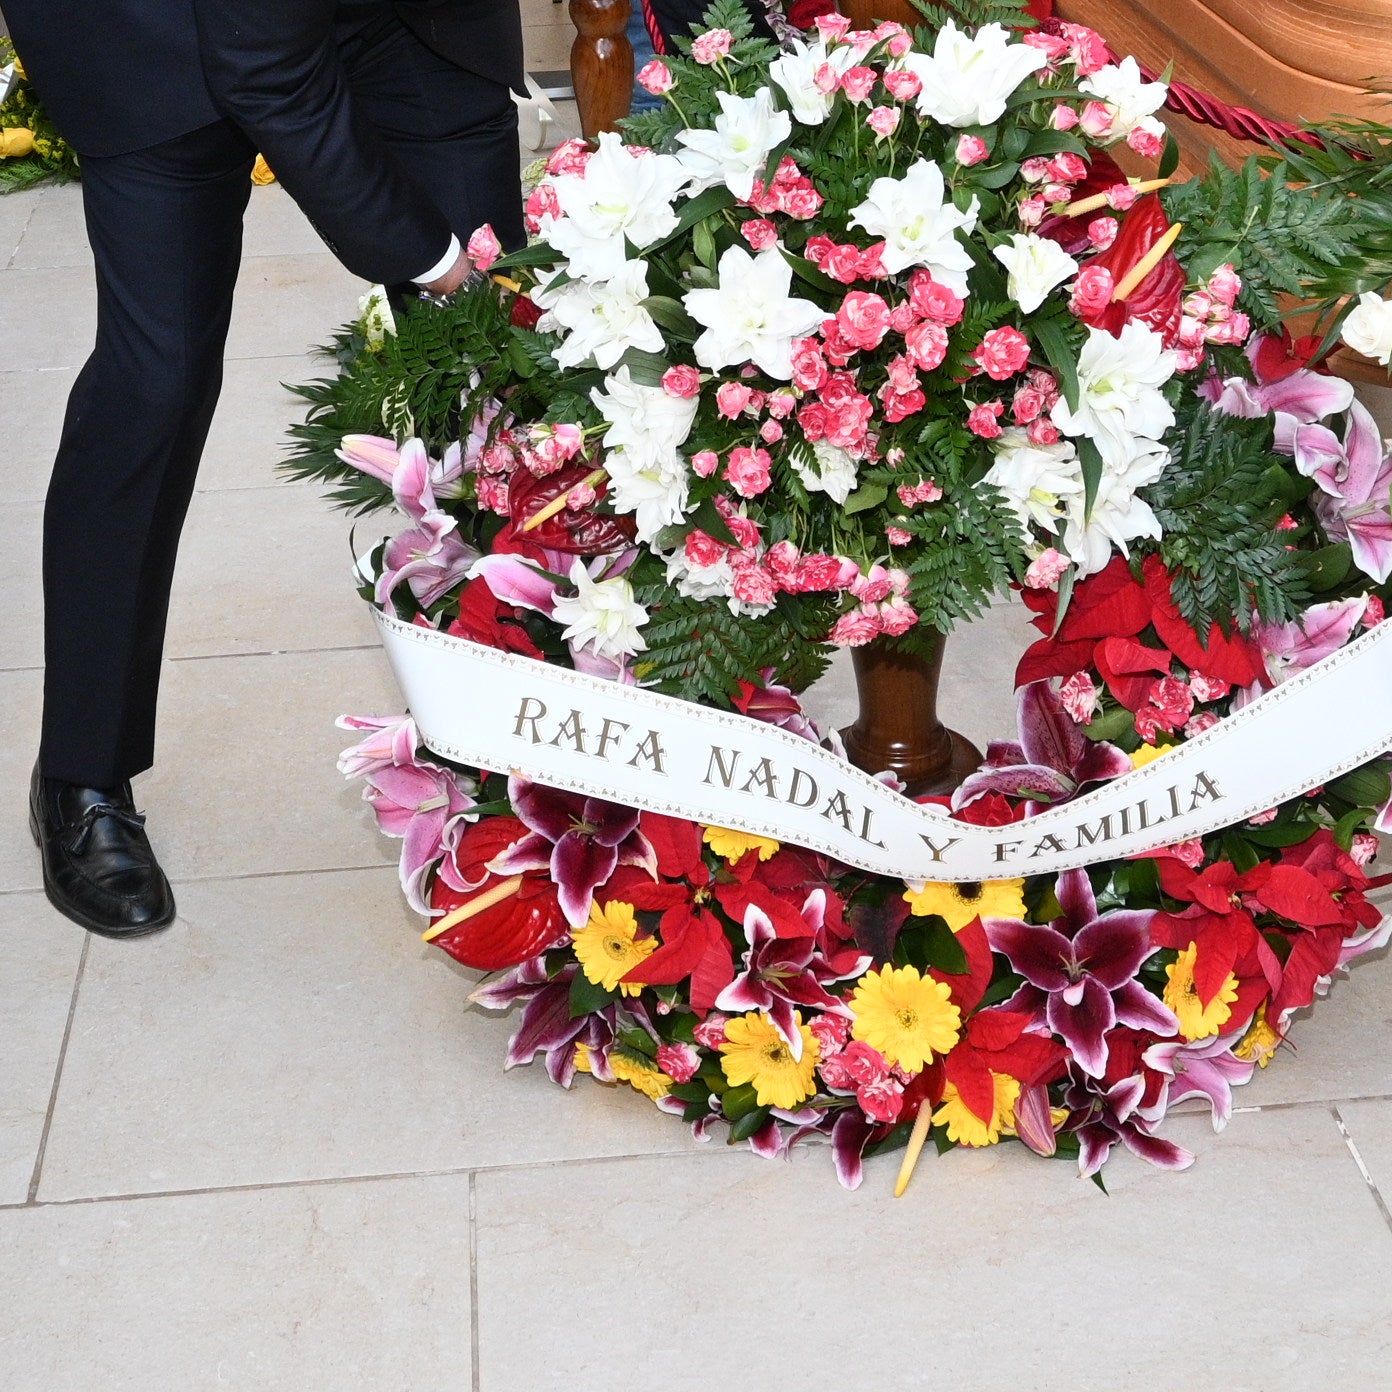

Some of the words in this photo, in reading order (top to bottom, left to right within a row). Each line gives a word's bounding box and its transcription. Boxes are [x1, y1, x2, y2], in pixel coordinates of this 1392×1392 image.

[511, 697, 668, 777] RAFA
[703, 745, 890, 851] NADAL
[916, 833, 959, 864] Y
[992, 770, 1227, 864] FAMILIA
